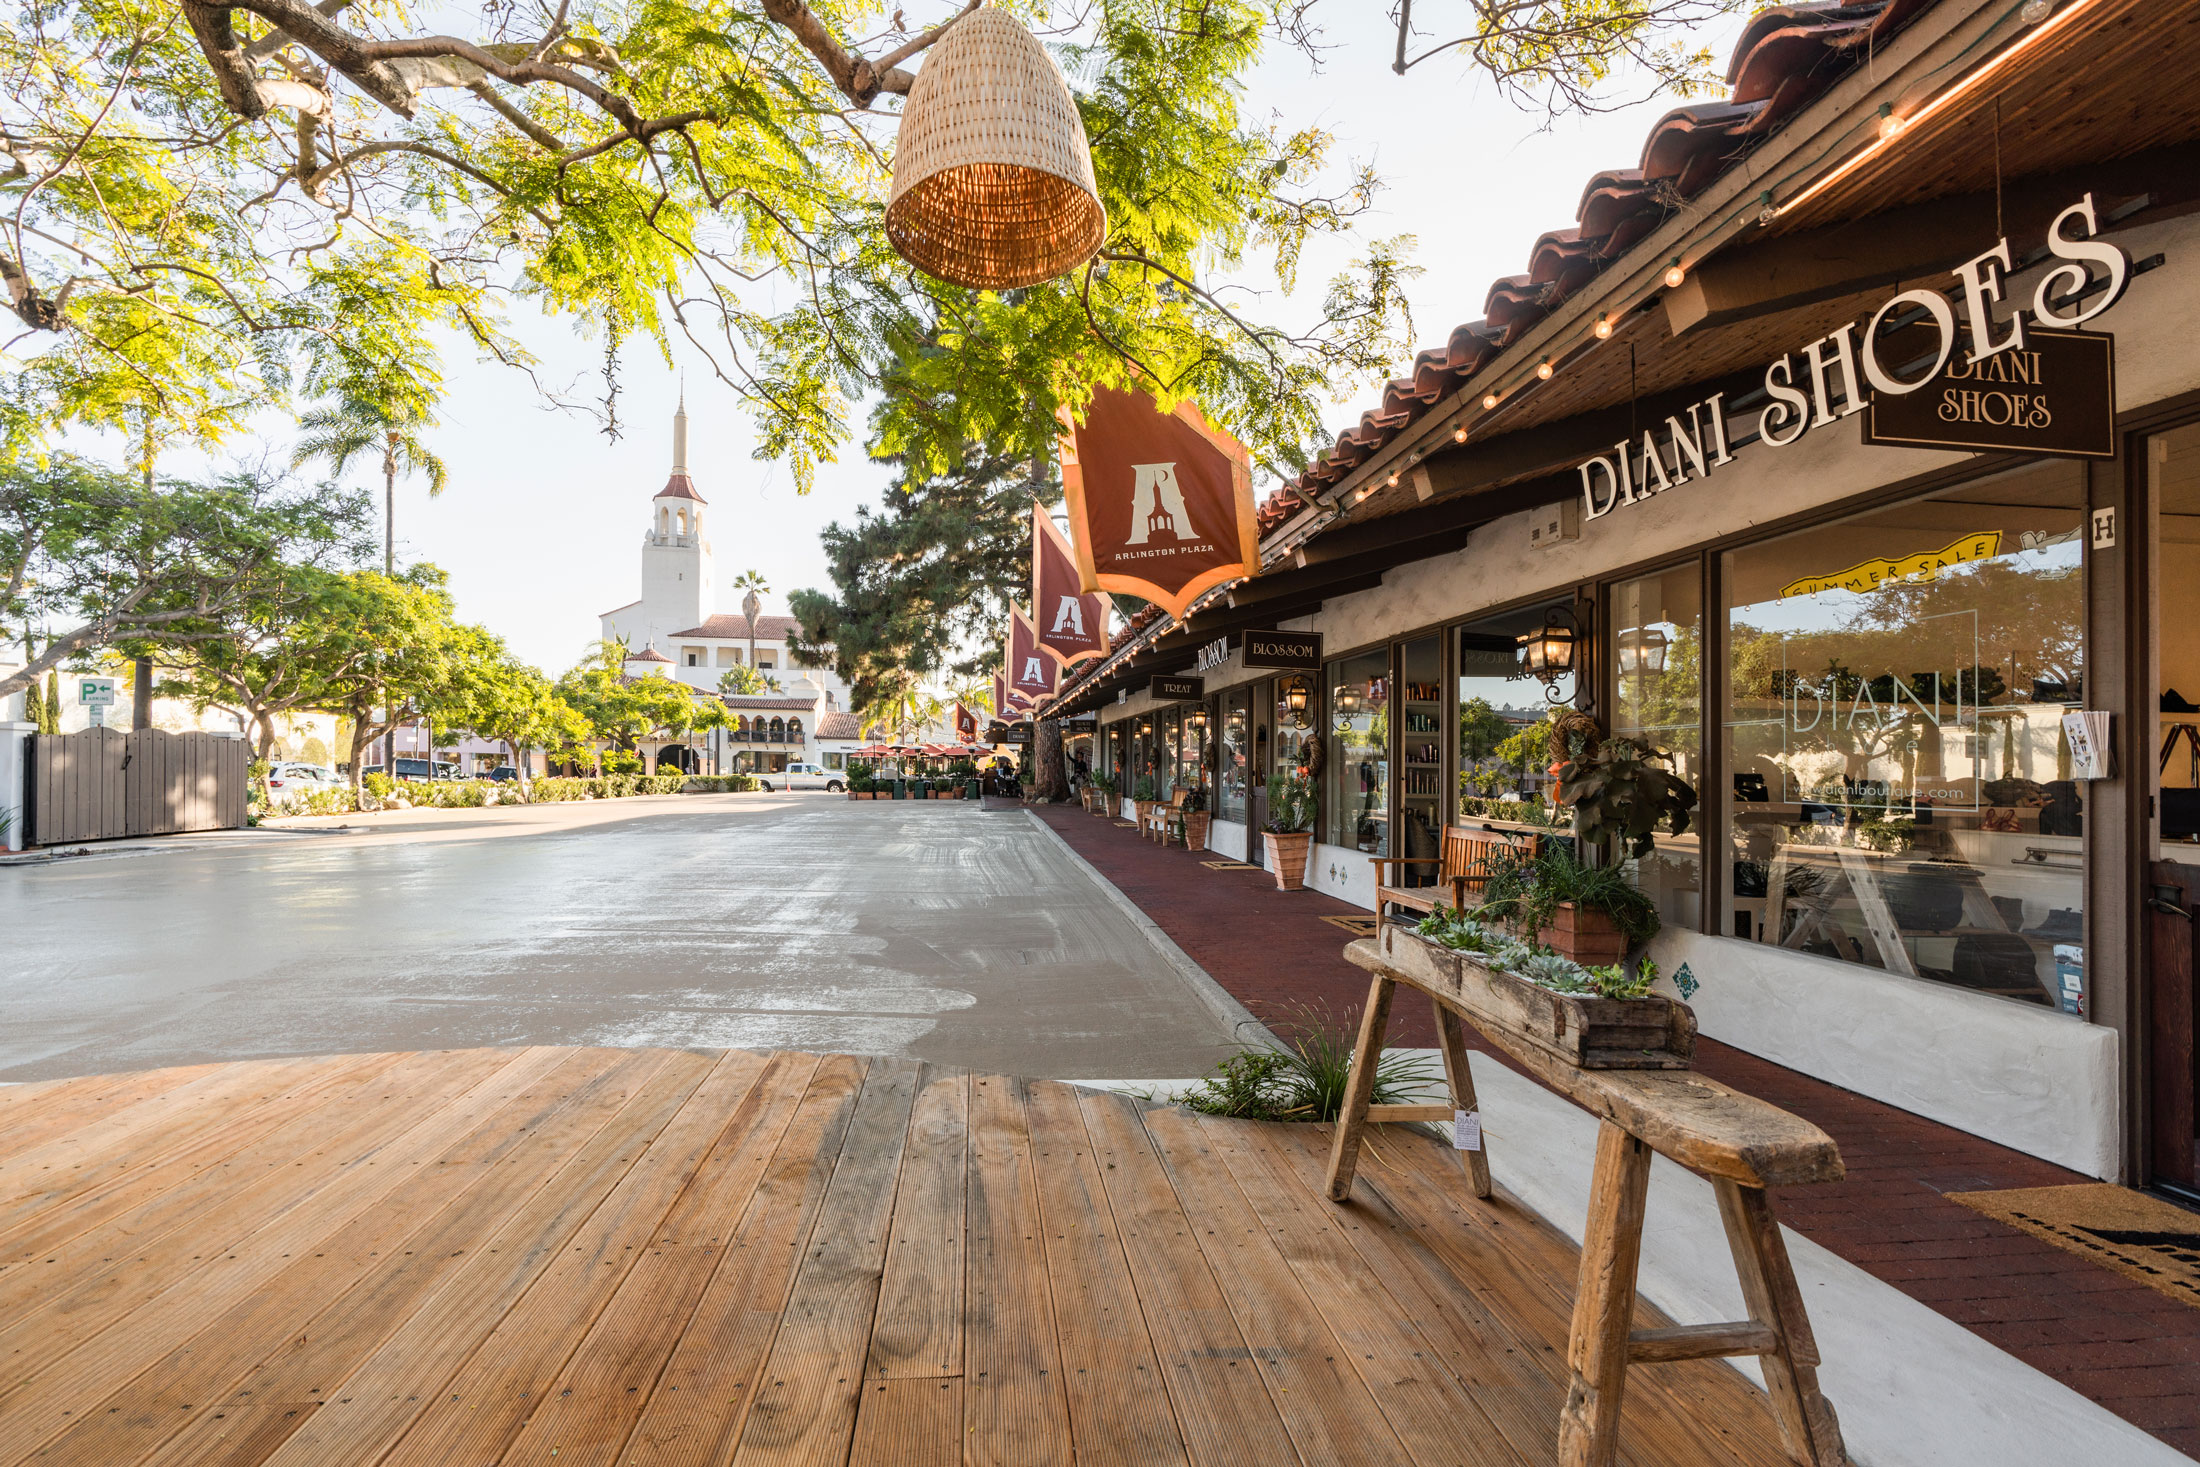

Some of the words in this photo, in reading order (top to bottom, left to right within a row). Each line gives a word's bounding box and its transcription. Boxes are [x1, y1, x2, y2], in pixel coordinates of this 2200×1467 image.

[1577, 392, 1735, 522] DIANI
[1759, 193, 2130, 447] SHOES
[1938, 388, 2051, 429] SHOES
[2095, 515, 2113, 541] H
[1115, 548, 1176, 560] ARLINGTON
[1181, 545, 1214, 554] PLAZA
[1919, 542, 1985, 576] SALE
[1198, 636, 1229, 672] BLOSSOM
[1253, 643, 1314, 657] BLOSSOM
[1164, 683, 1192, 693] TREAT
[1793, 668, 1962, 733] DIANI
